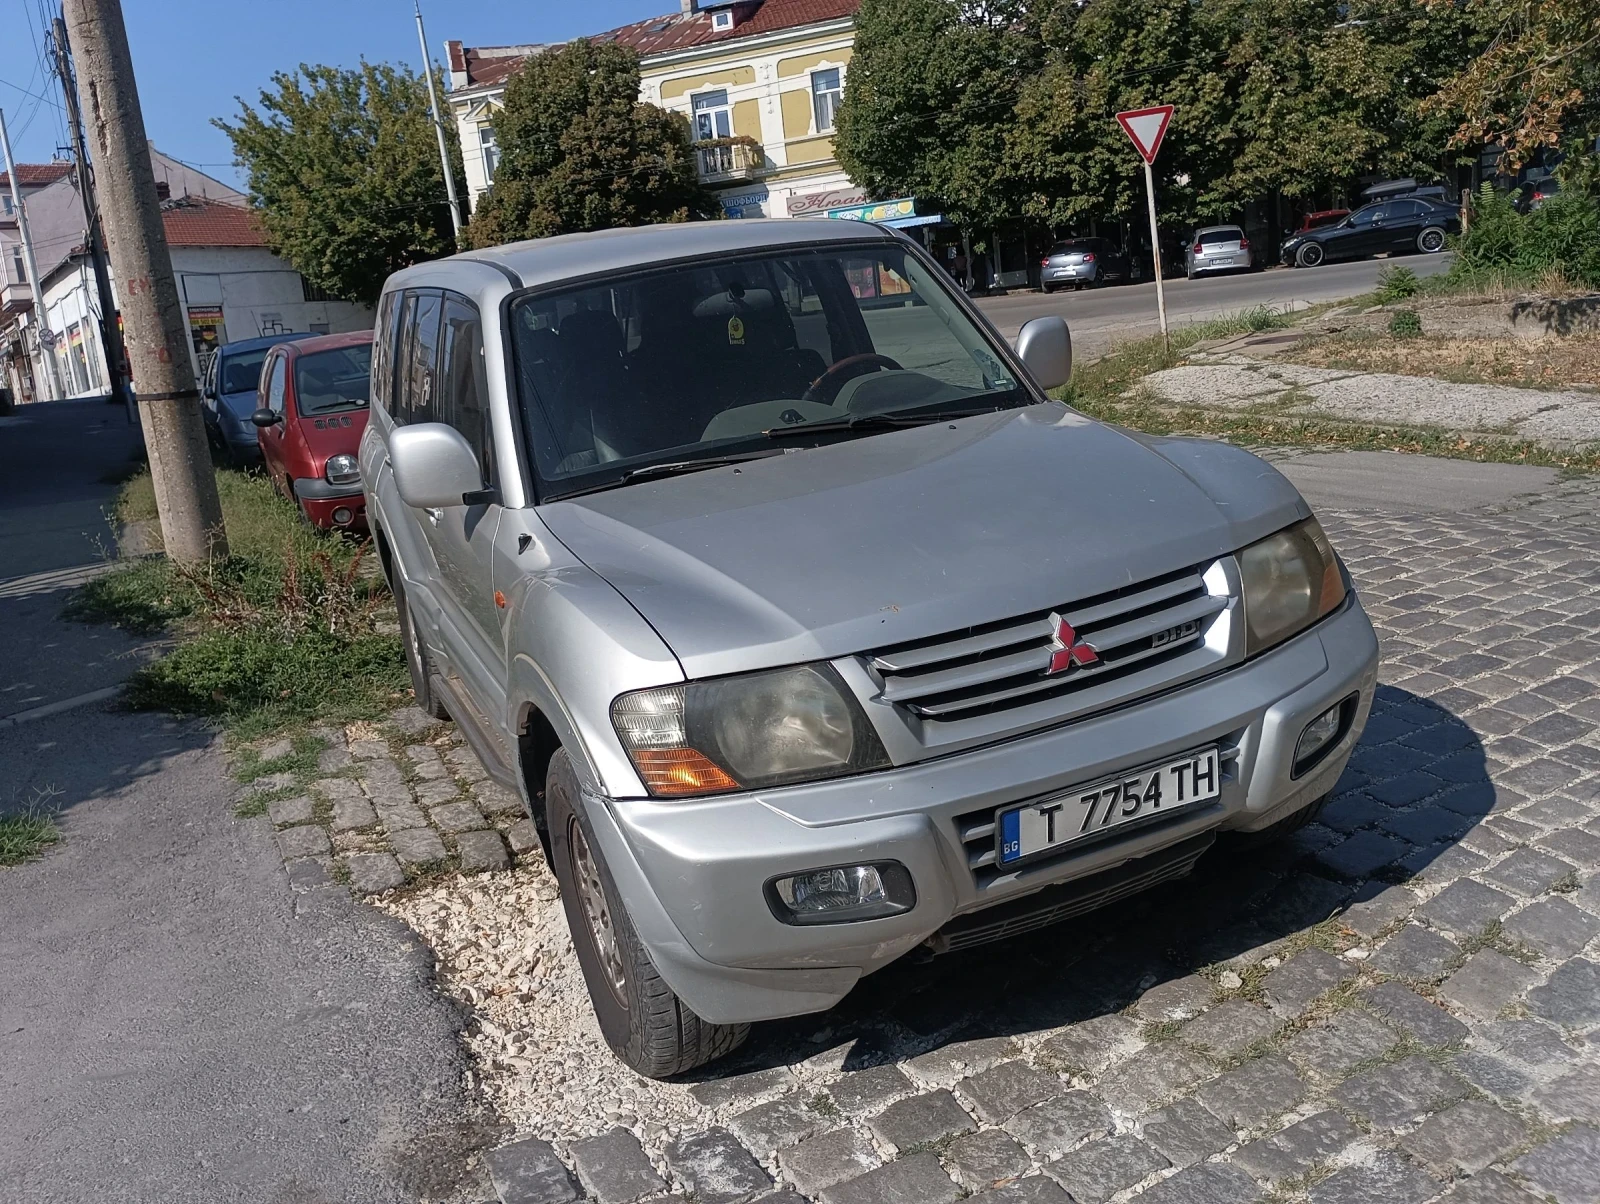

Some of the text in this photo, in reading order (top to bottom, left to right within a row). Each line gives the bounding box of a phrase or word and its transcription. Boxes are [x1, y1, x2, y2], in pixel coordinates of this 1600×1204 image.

[1039, 755, 1214, 843] T 7754 TH
[1003, 840, 1019, 854] BG
